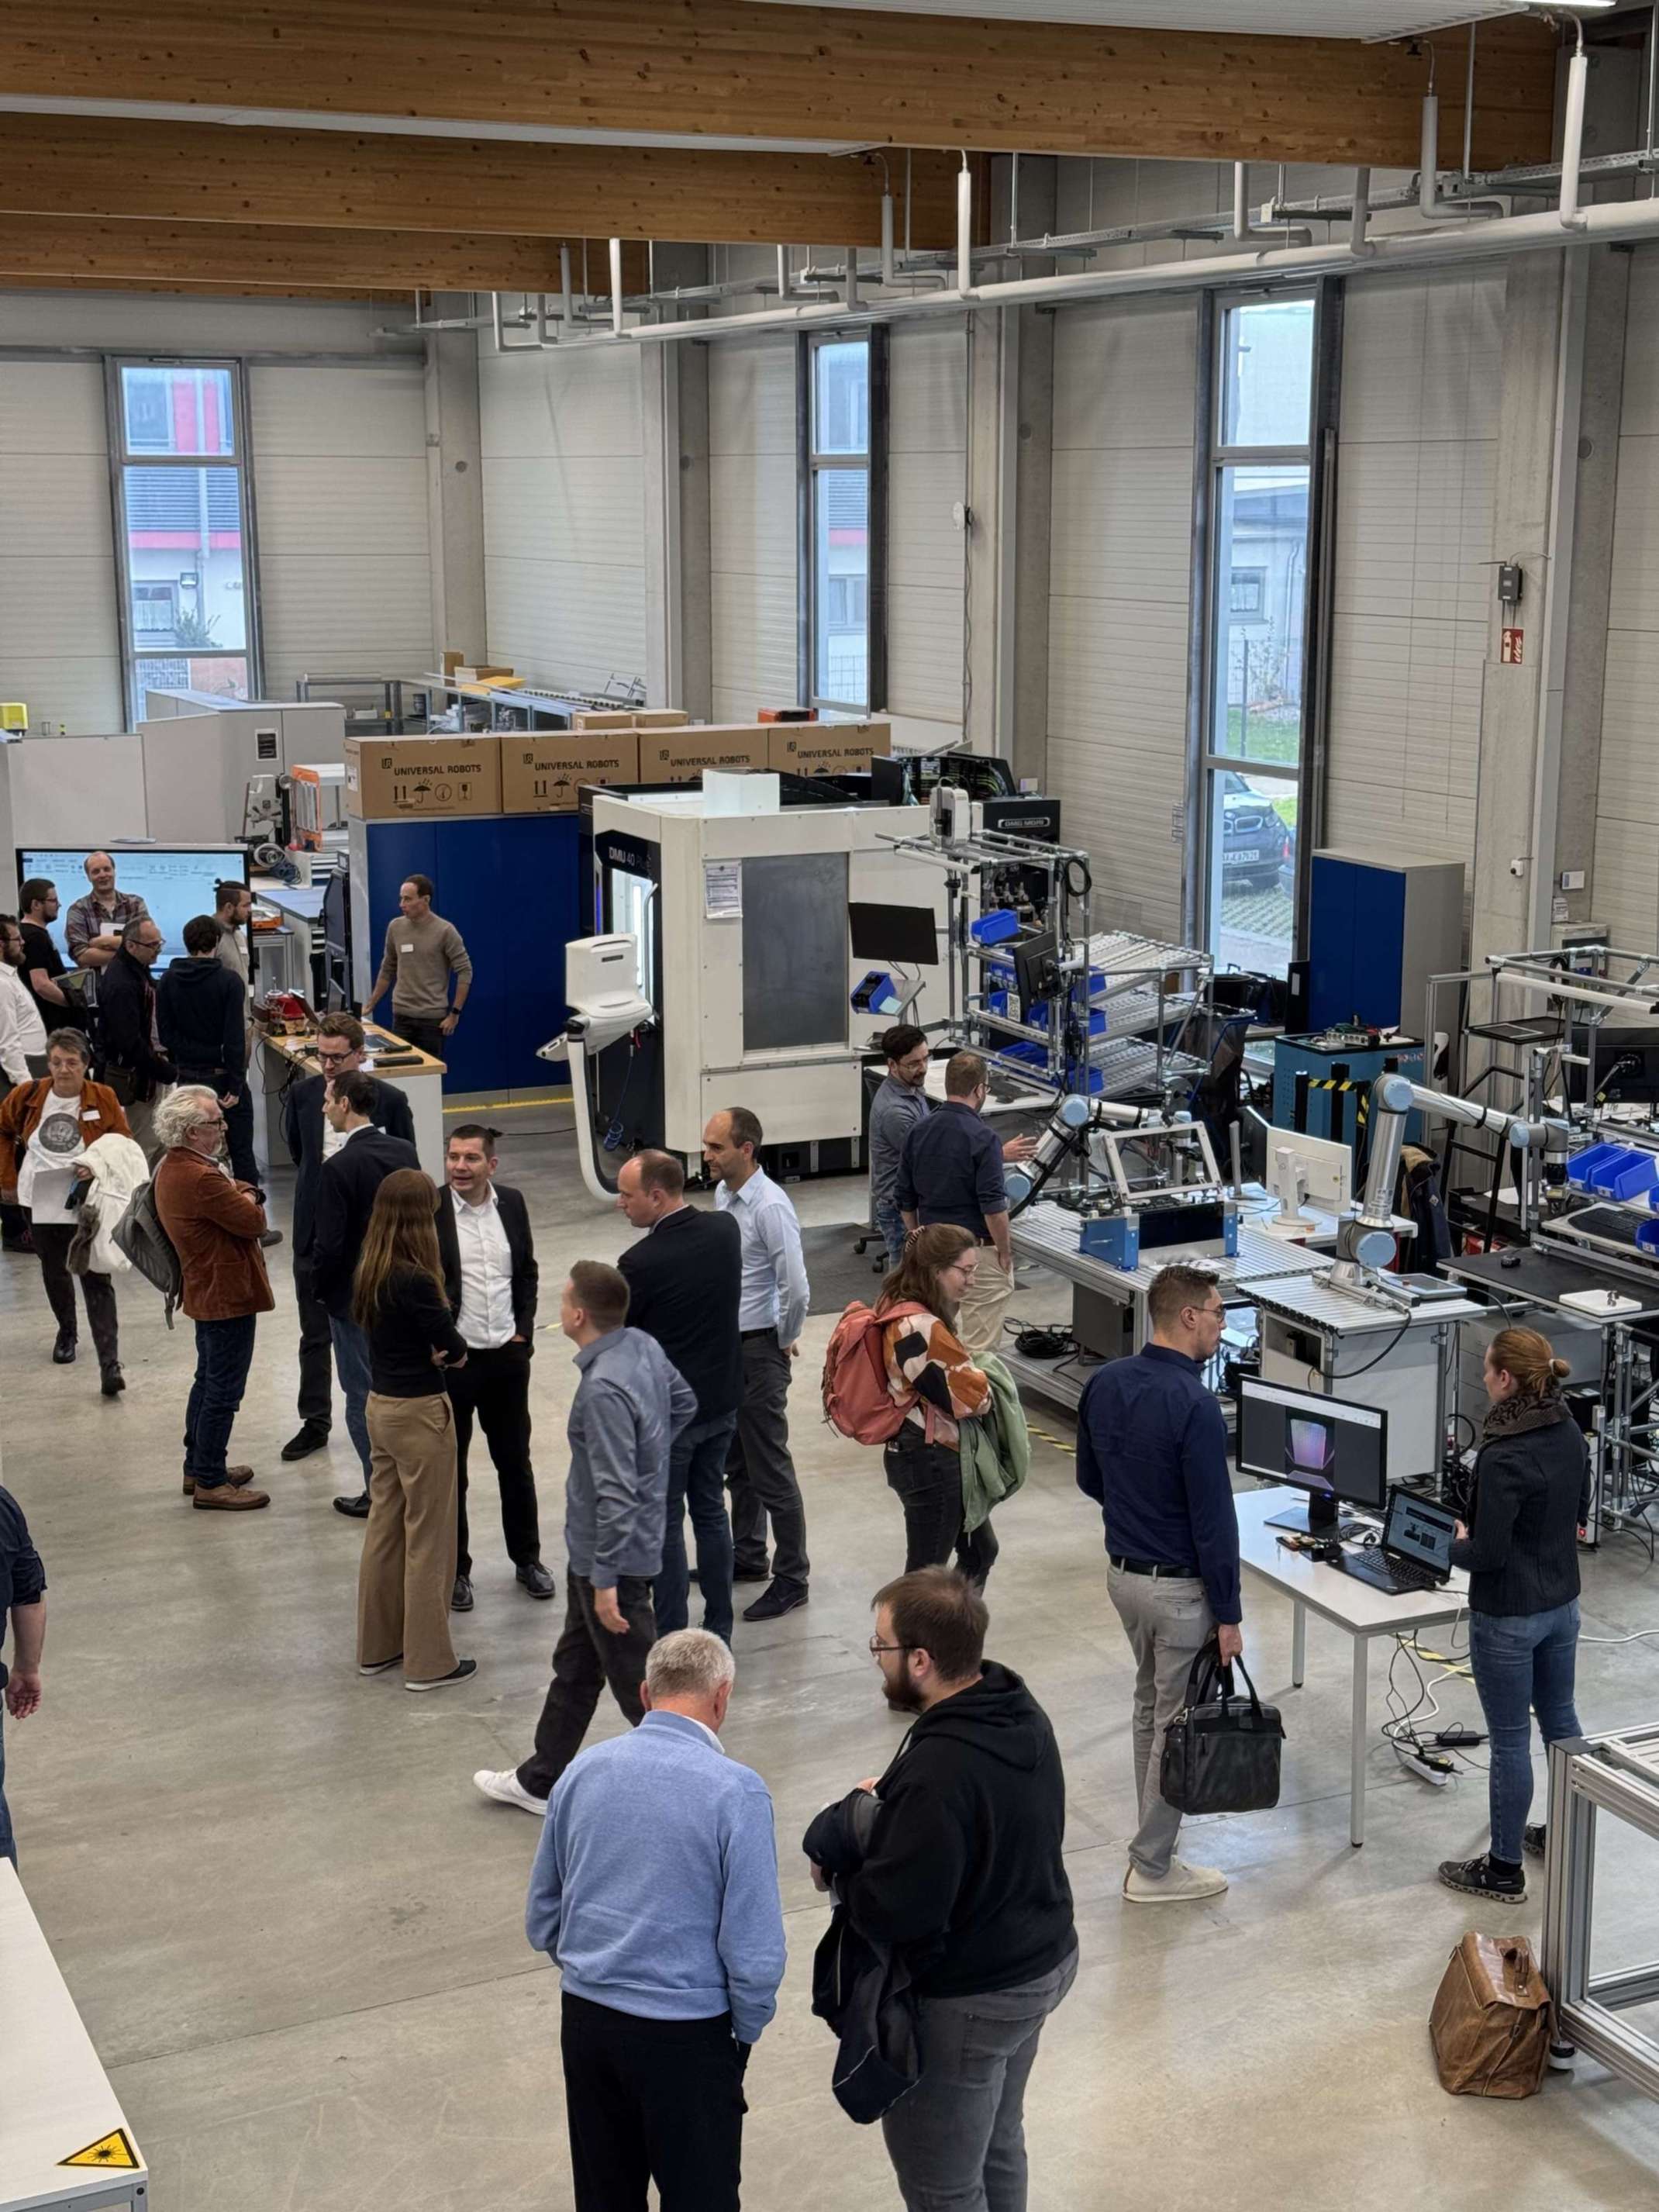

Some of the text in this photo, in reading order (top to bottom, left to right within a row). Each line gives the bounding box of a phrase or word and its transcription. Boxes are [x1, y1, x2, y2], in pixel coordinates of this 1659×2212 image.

[798, 747, 874, 758] UNIVERSAL ROBOTS
[535, 760, 619, 771] UNIVERSAL ROBOTS
[671, 755, 750, 767] UNIVERSAL ROBOTS
[394, 764, 481, 775] UNIVERSAL ROBOTS
[609, 847, 626, 863] DMU
[626, 853, 635, 866] 40
